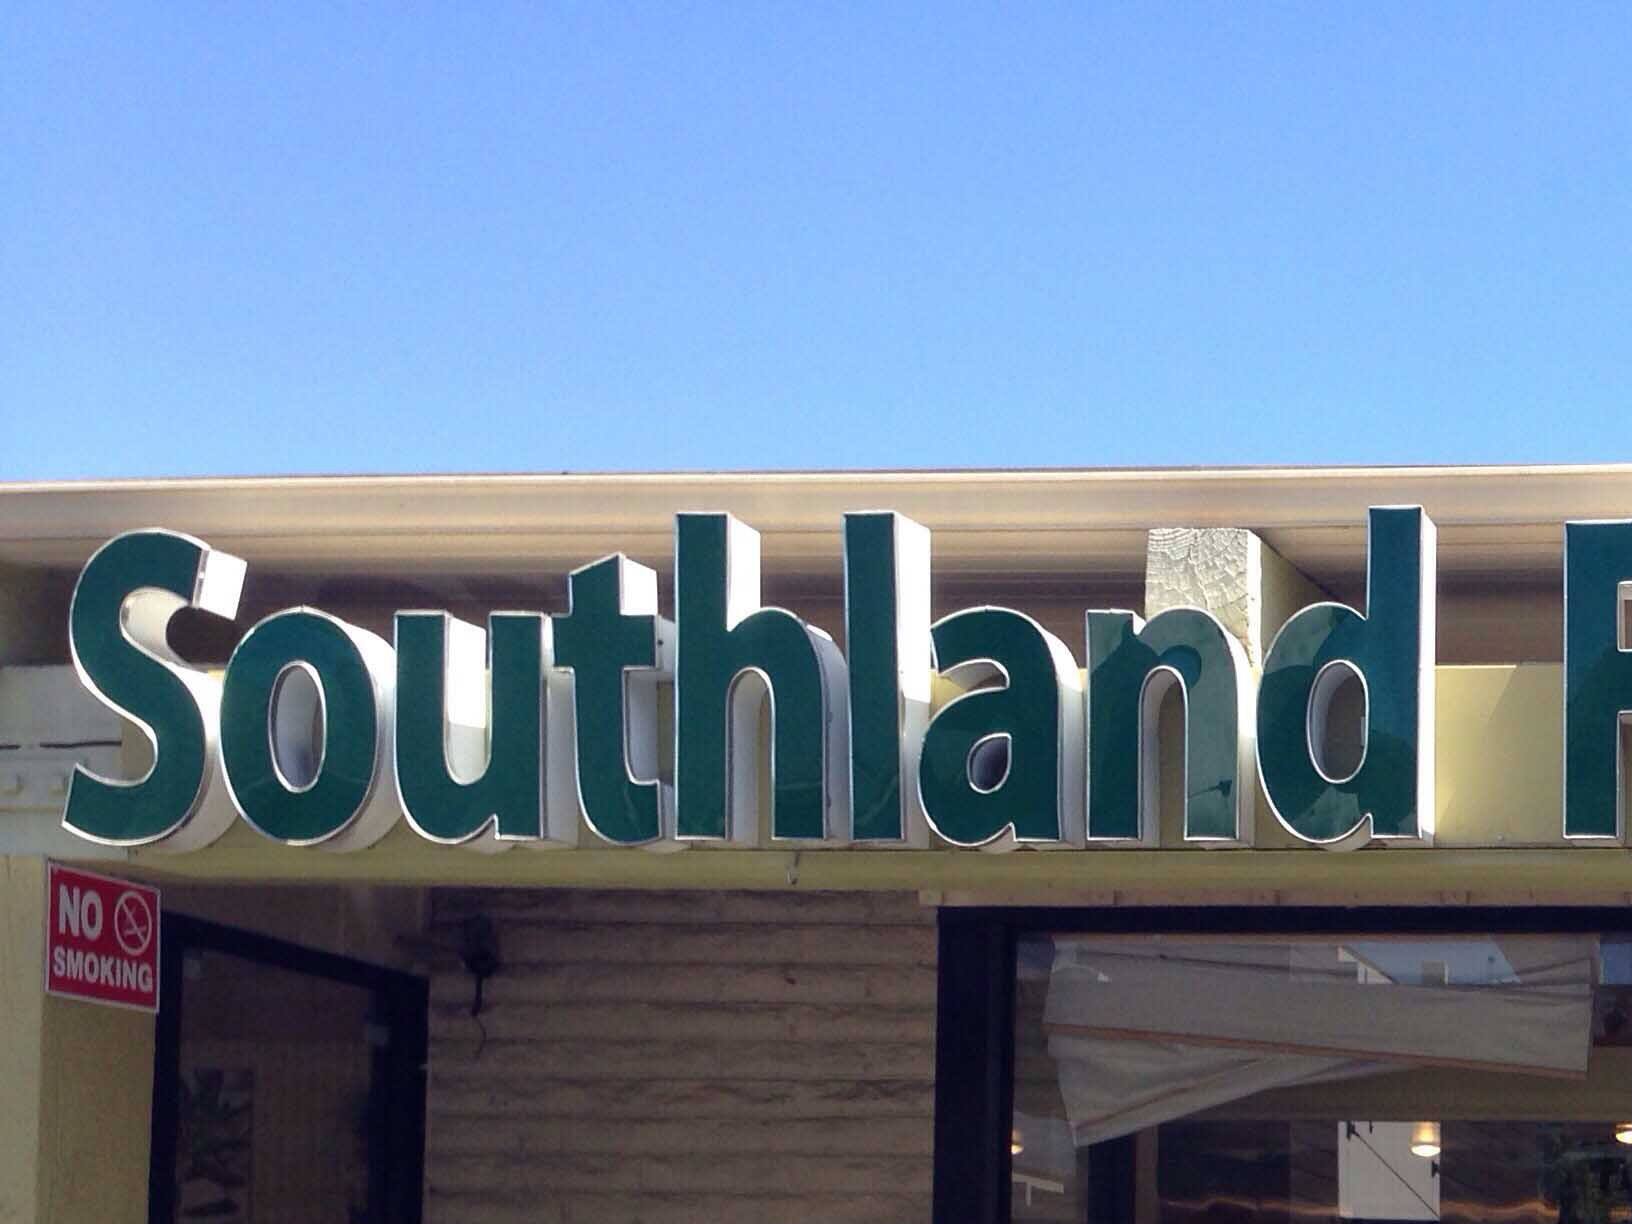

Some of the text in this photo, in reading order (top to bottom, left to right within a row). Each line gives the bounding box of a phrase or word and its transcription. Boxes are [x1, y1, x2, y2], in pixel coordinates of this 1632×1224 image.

[62, 504, 1434, 850] Southland
[58, 884, 102, 940] NO
[52, 944, 154, 993] SMOKING
